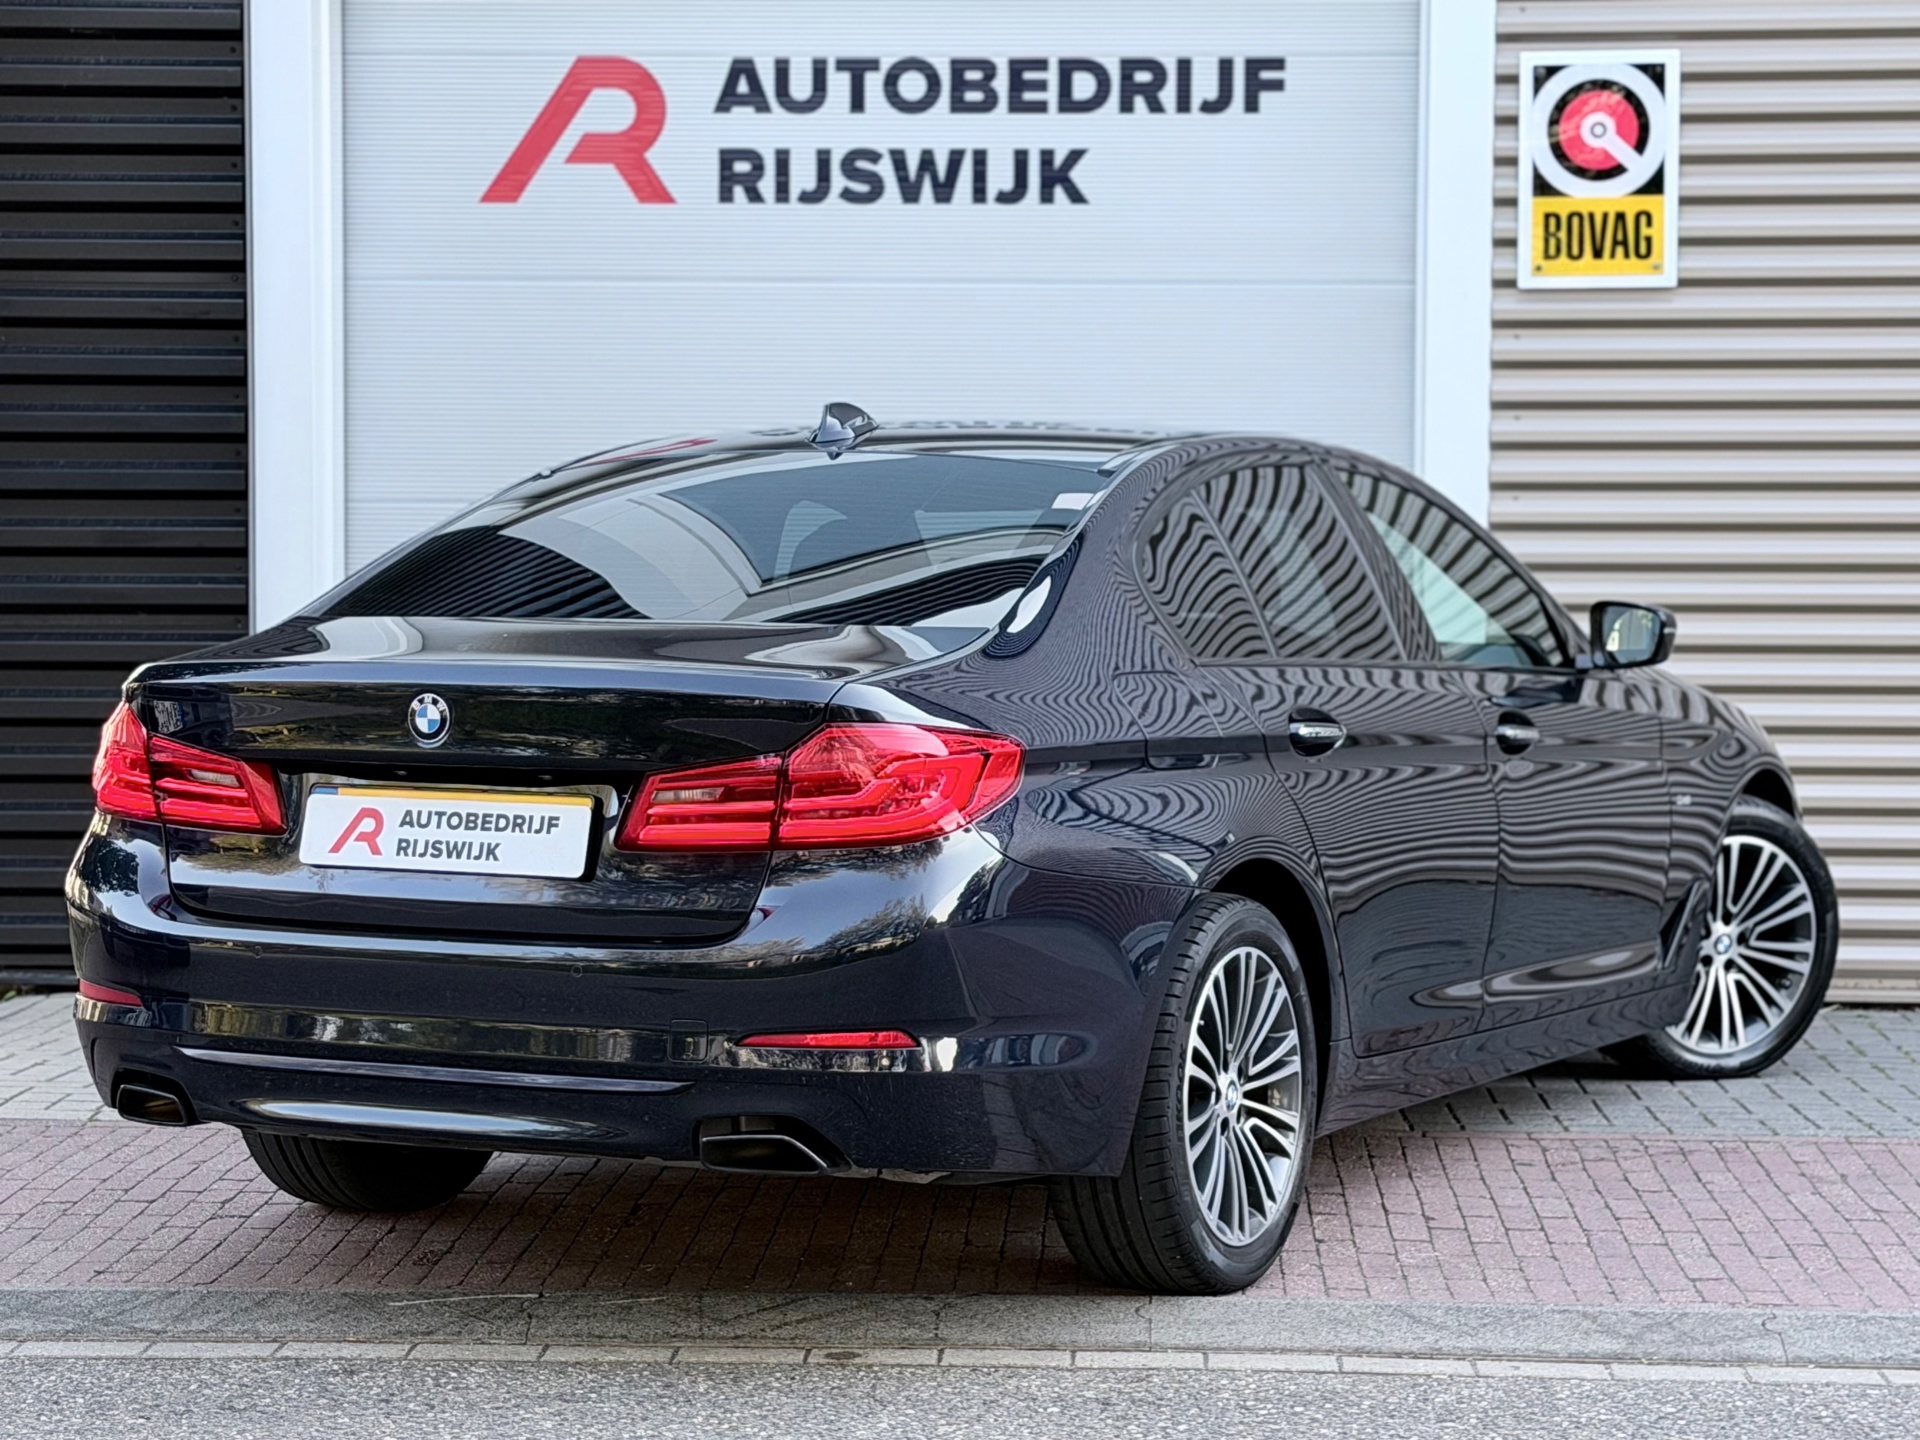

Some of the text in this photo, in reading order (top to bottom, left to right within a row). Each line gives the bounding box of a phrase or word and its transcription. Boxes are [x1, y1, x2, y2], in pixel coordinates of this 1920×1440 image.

[713, 57, 1286, 114] AUTOBEDRIJF
[717, 148, 1088, 204] RIJSWIJK
[1543, 210, 1653, 261] BOVAG
[398, 809, 561, 835] AUTOBEDRIJF
[396, 838, 501, 862] RIJSWIJK
